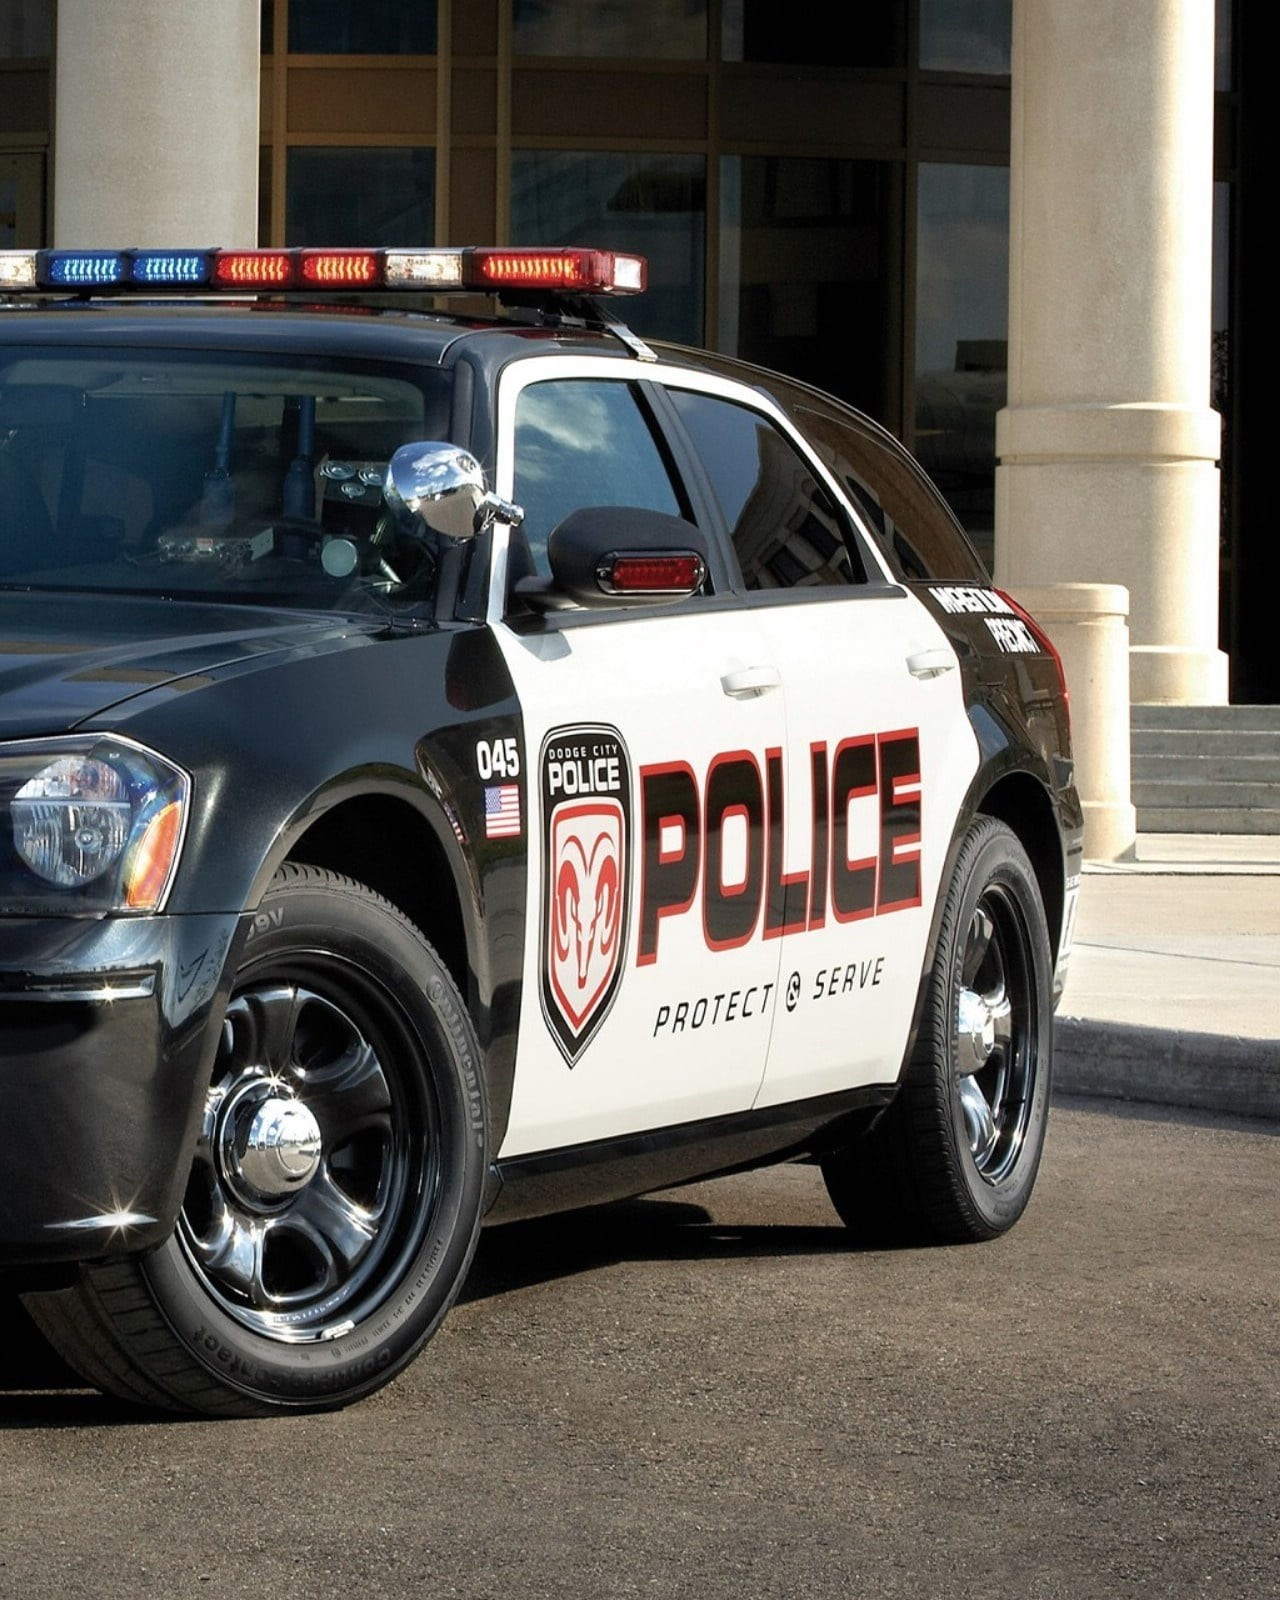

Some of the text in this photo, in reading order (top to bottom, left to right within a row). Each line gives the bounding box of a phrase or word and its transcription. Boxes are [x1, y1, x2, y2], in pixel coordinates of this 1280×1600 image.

[476, 738, 520, 780] 045
[548, 744, 618, 760] DODGE CITY
[548, 757, 621, 796] POLICE
[636, 727, 923, 967] POLICE
[653, 983, 774, 1038] PROTECT
[812, 957, 885, 1000] SERVE
